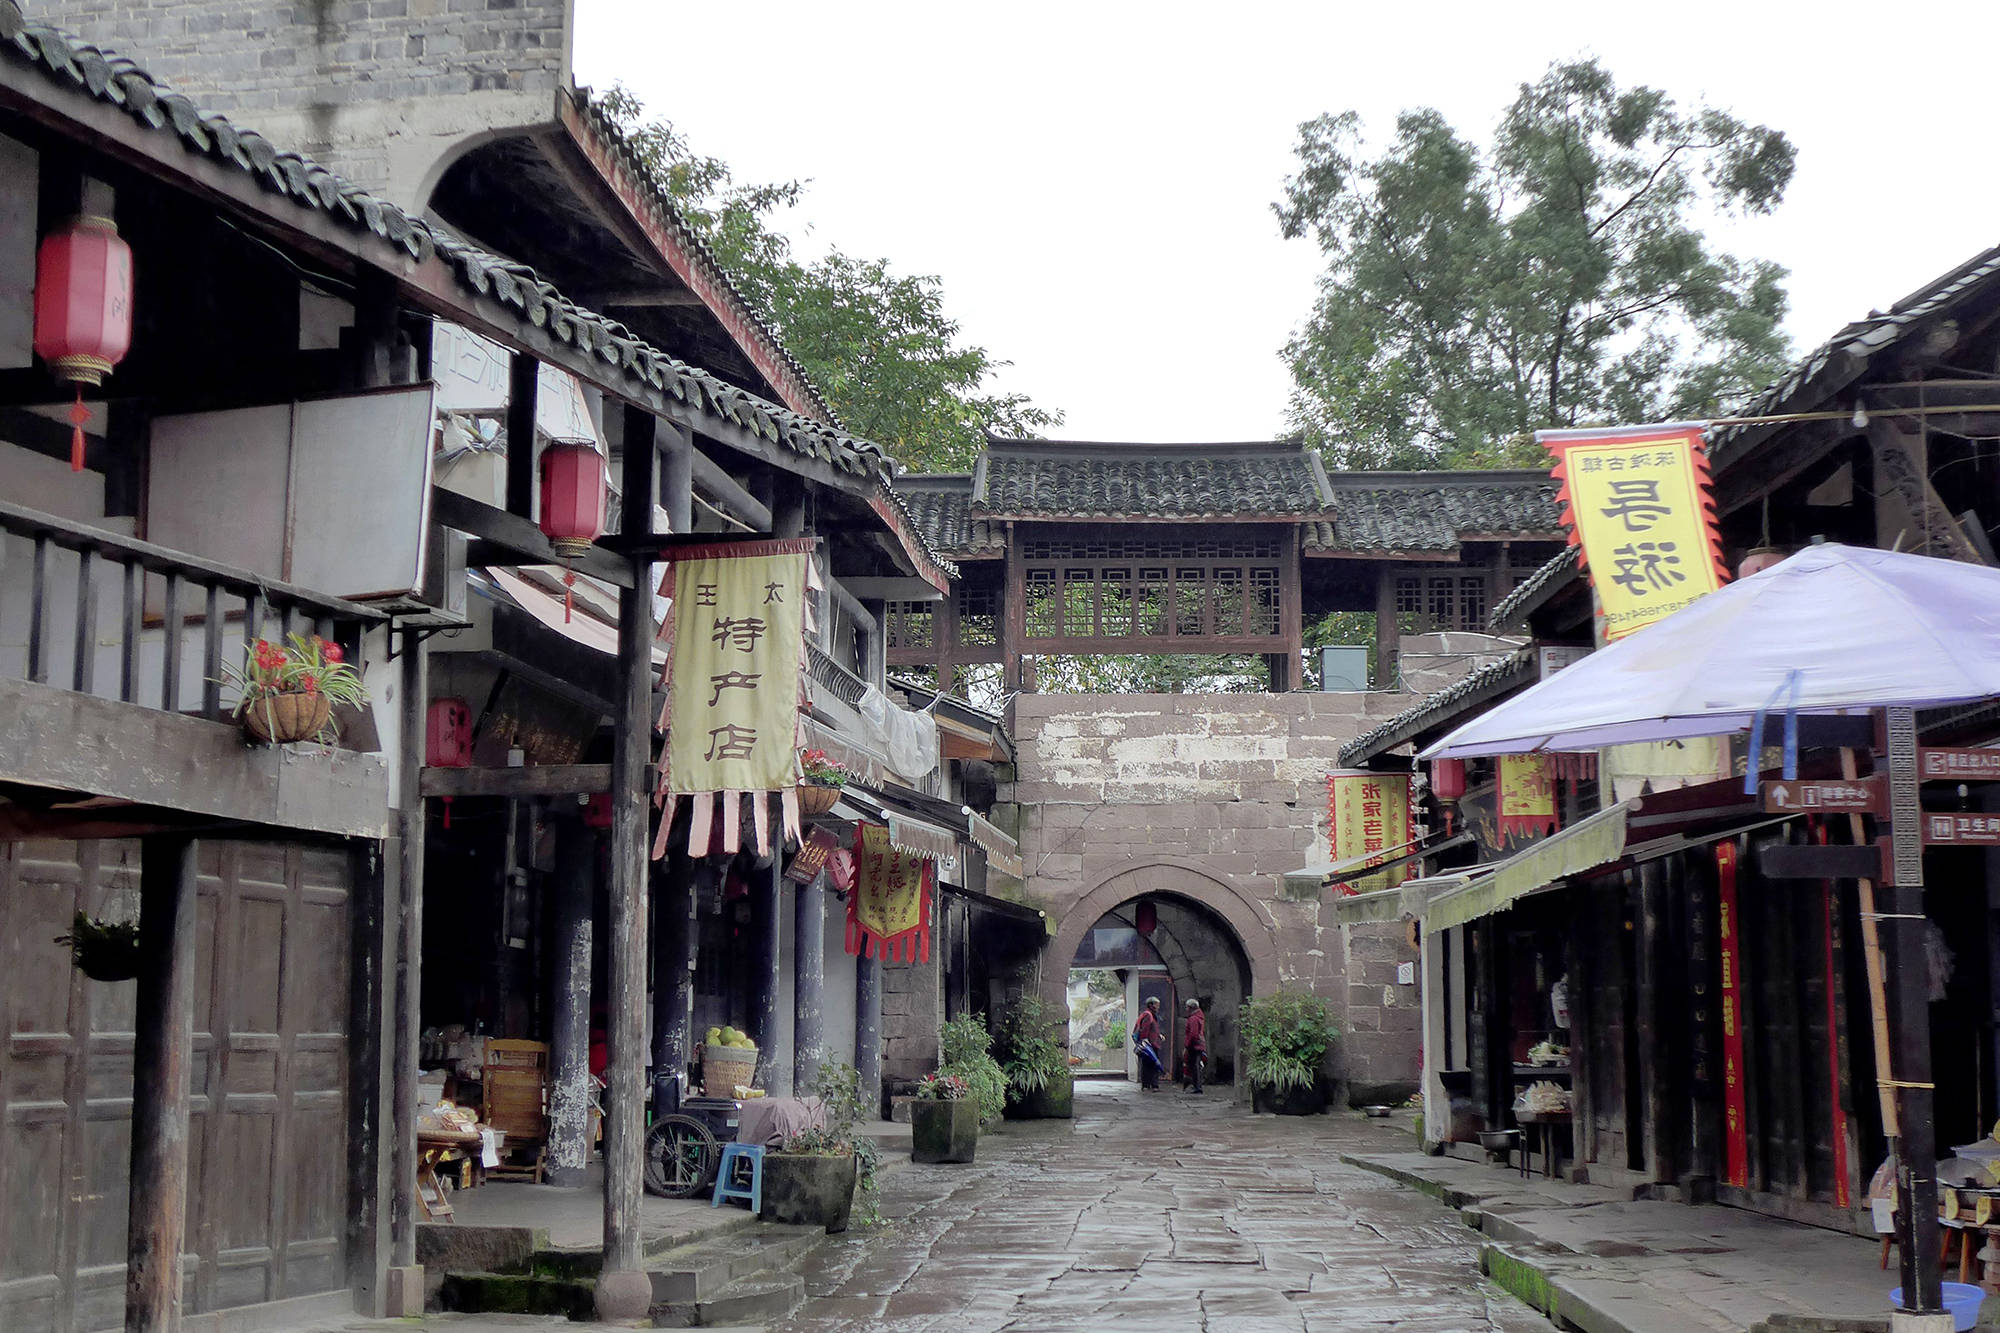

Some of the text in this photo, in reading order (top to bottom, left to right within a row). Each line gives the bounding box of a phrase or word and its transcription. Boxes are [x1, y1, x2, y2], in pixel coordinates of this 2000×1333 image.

[704, 616, 767, 762] 特产店
[1957, 818, 2000, 832] 卫生间
